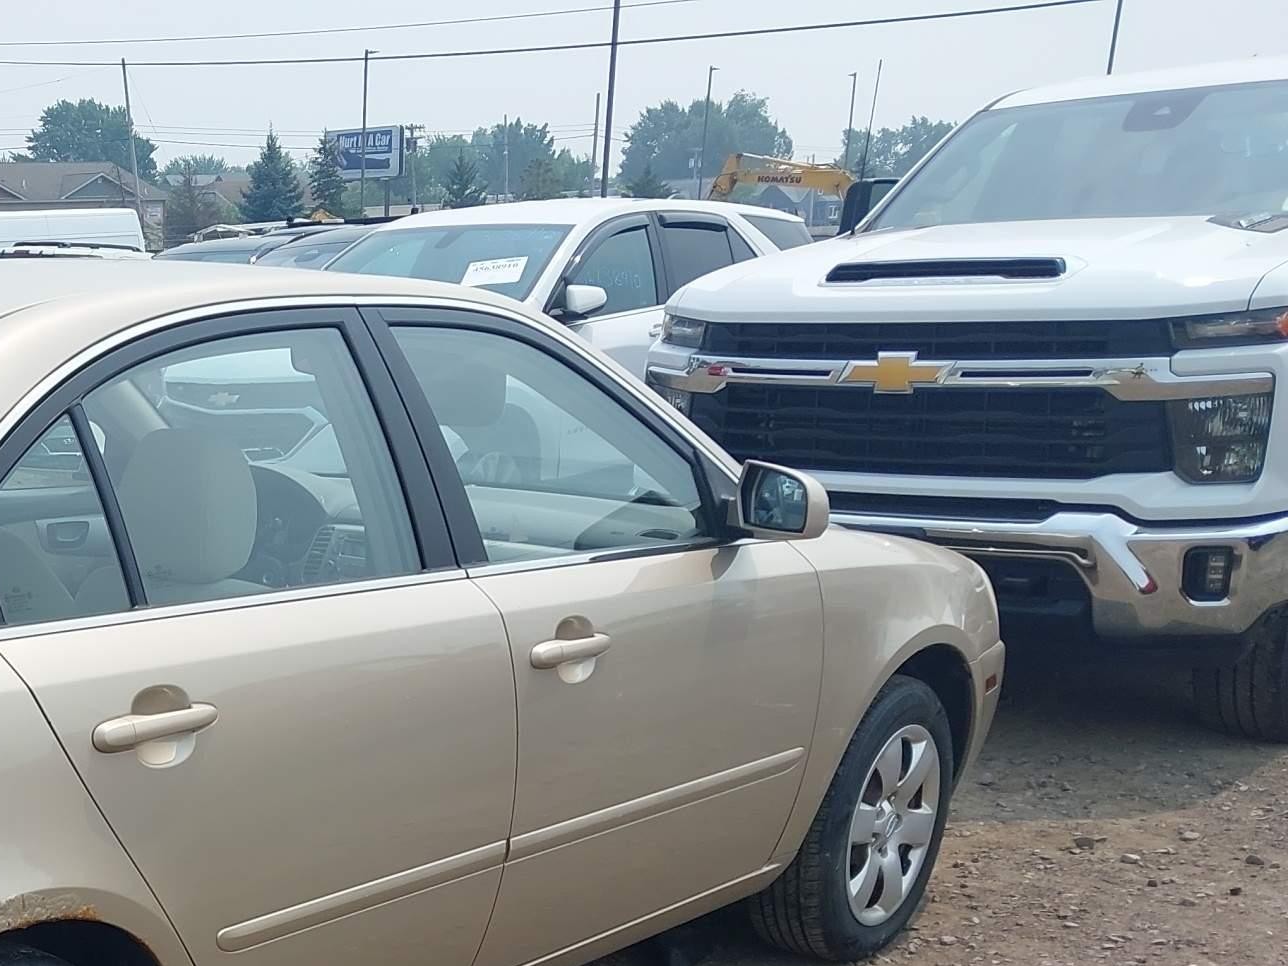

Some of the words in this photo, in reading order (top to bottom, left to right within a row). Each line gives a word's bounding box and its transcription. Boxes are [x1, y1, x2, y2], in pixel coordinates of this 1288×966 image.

[339, 135, 357, 148] Hurt
[368, 133, 374, 147] A
[375, 132, 391, 146] Car
[757, 175, 802, 184] KOMATSU
